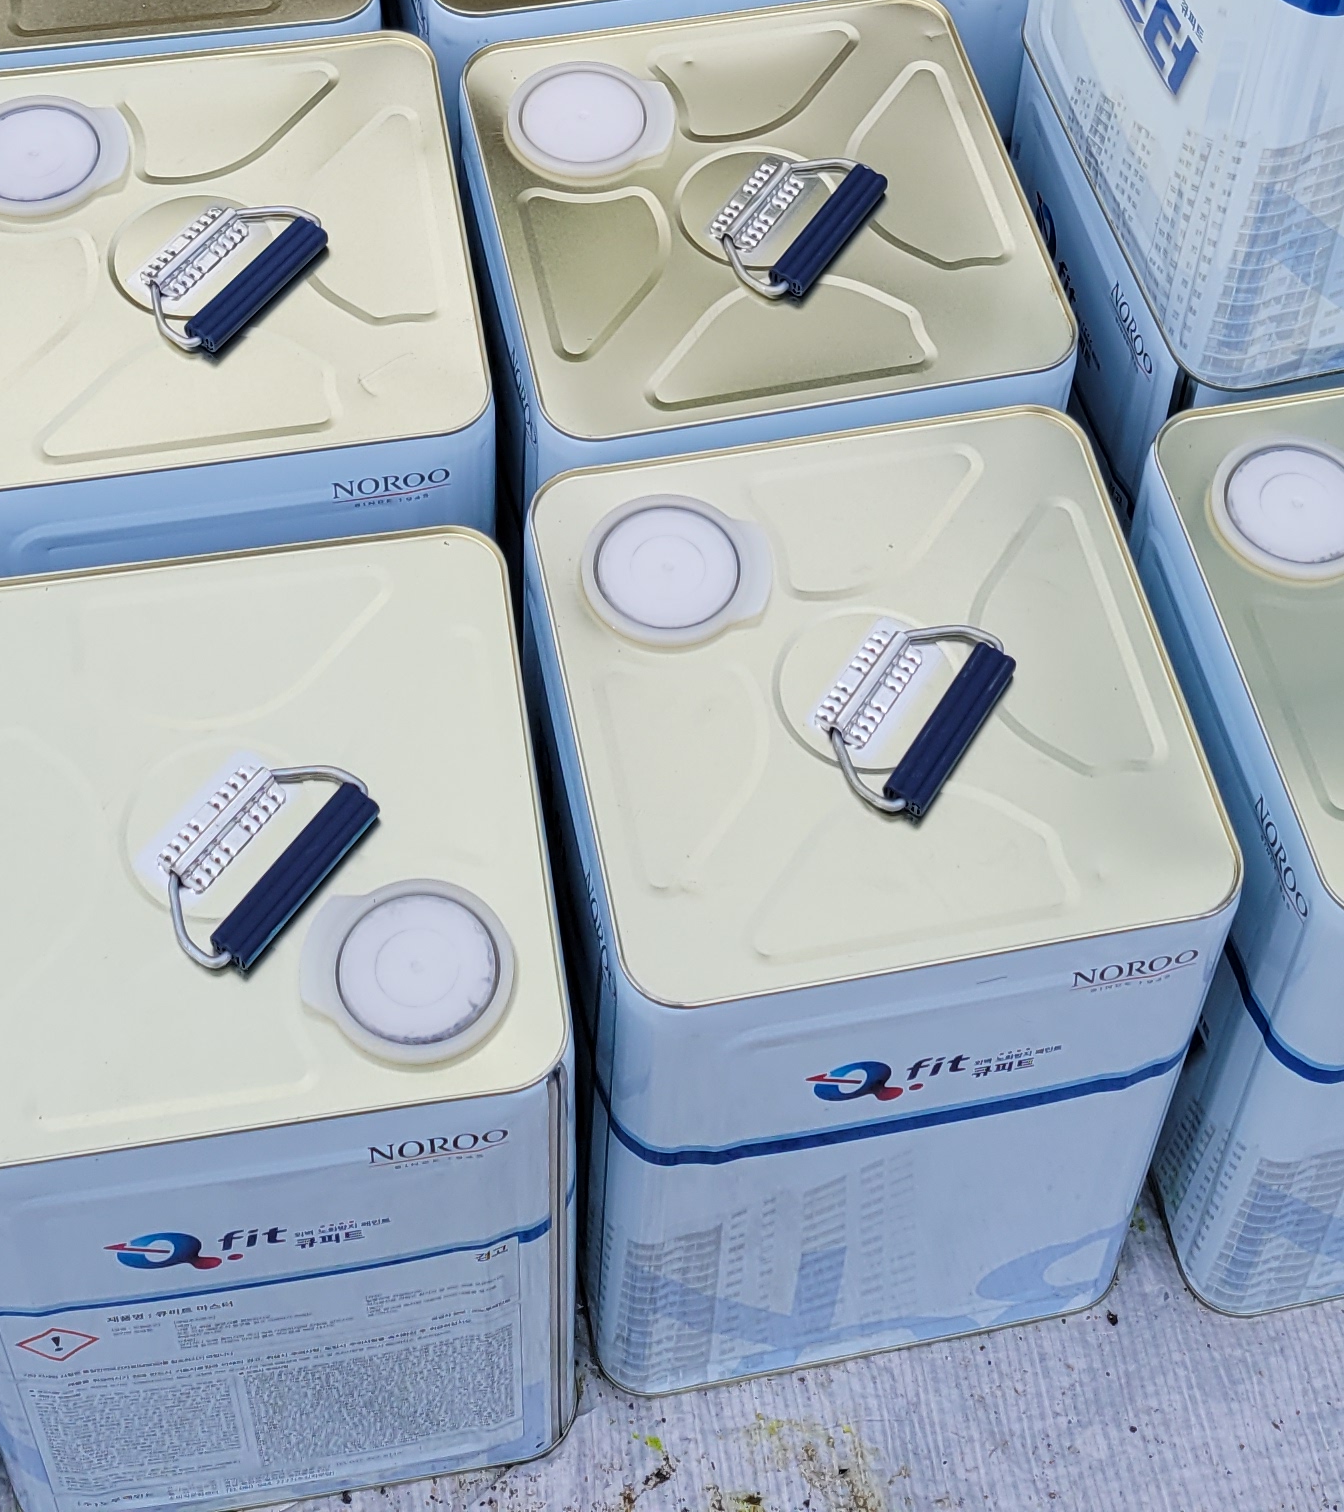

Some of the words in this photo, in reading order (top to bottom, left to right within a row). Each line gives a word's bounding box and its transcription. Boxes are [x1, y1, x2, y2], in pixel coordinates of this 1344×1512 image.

[1110, 280, 1153, 375] NOROO
[331, 468, 450, 499] NOROO
[1255, 793, 1308, 918] NOROO
[1072, 949, 1199, 988] NOROO
[906, 1054, 971, 1081] fit
[972, 1057, 1036, 1078] 큐피트
[367, 1129, 509, 1164] NOROO
[218, 1226, 287, 1251] fit
[294, 1230, 365, 1250] 큐피트
